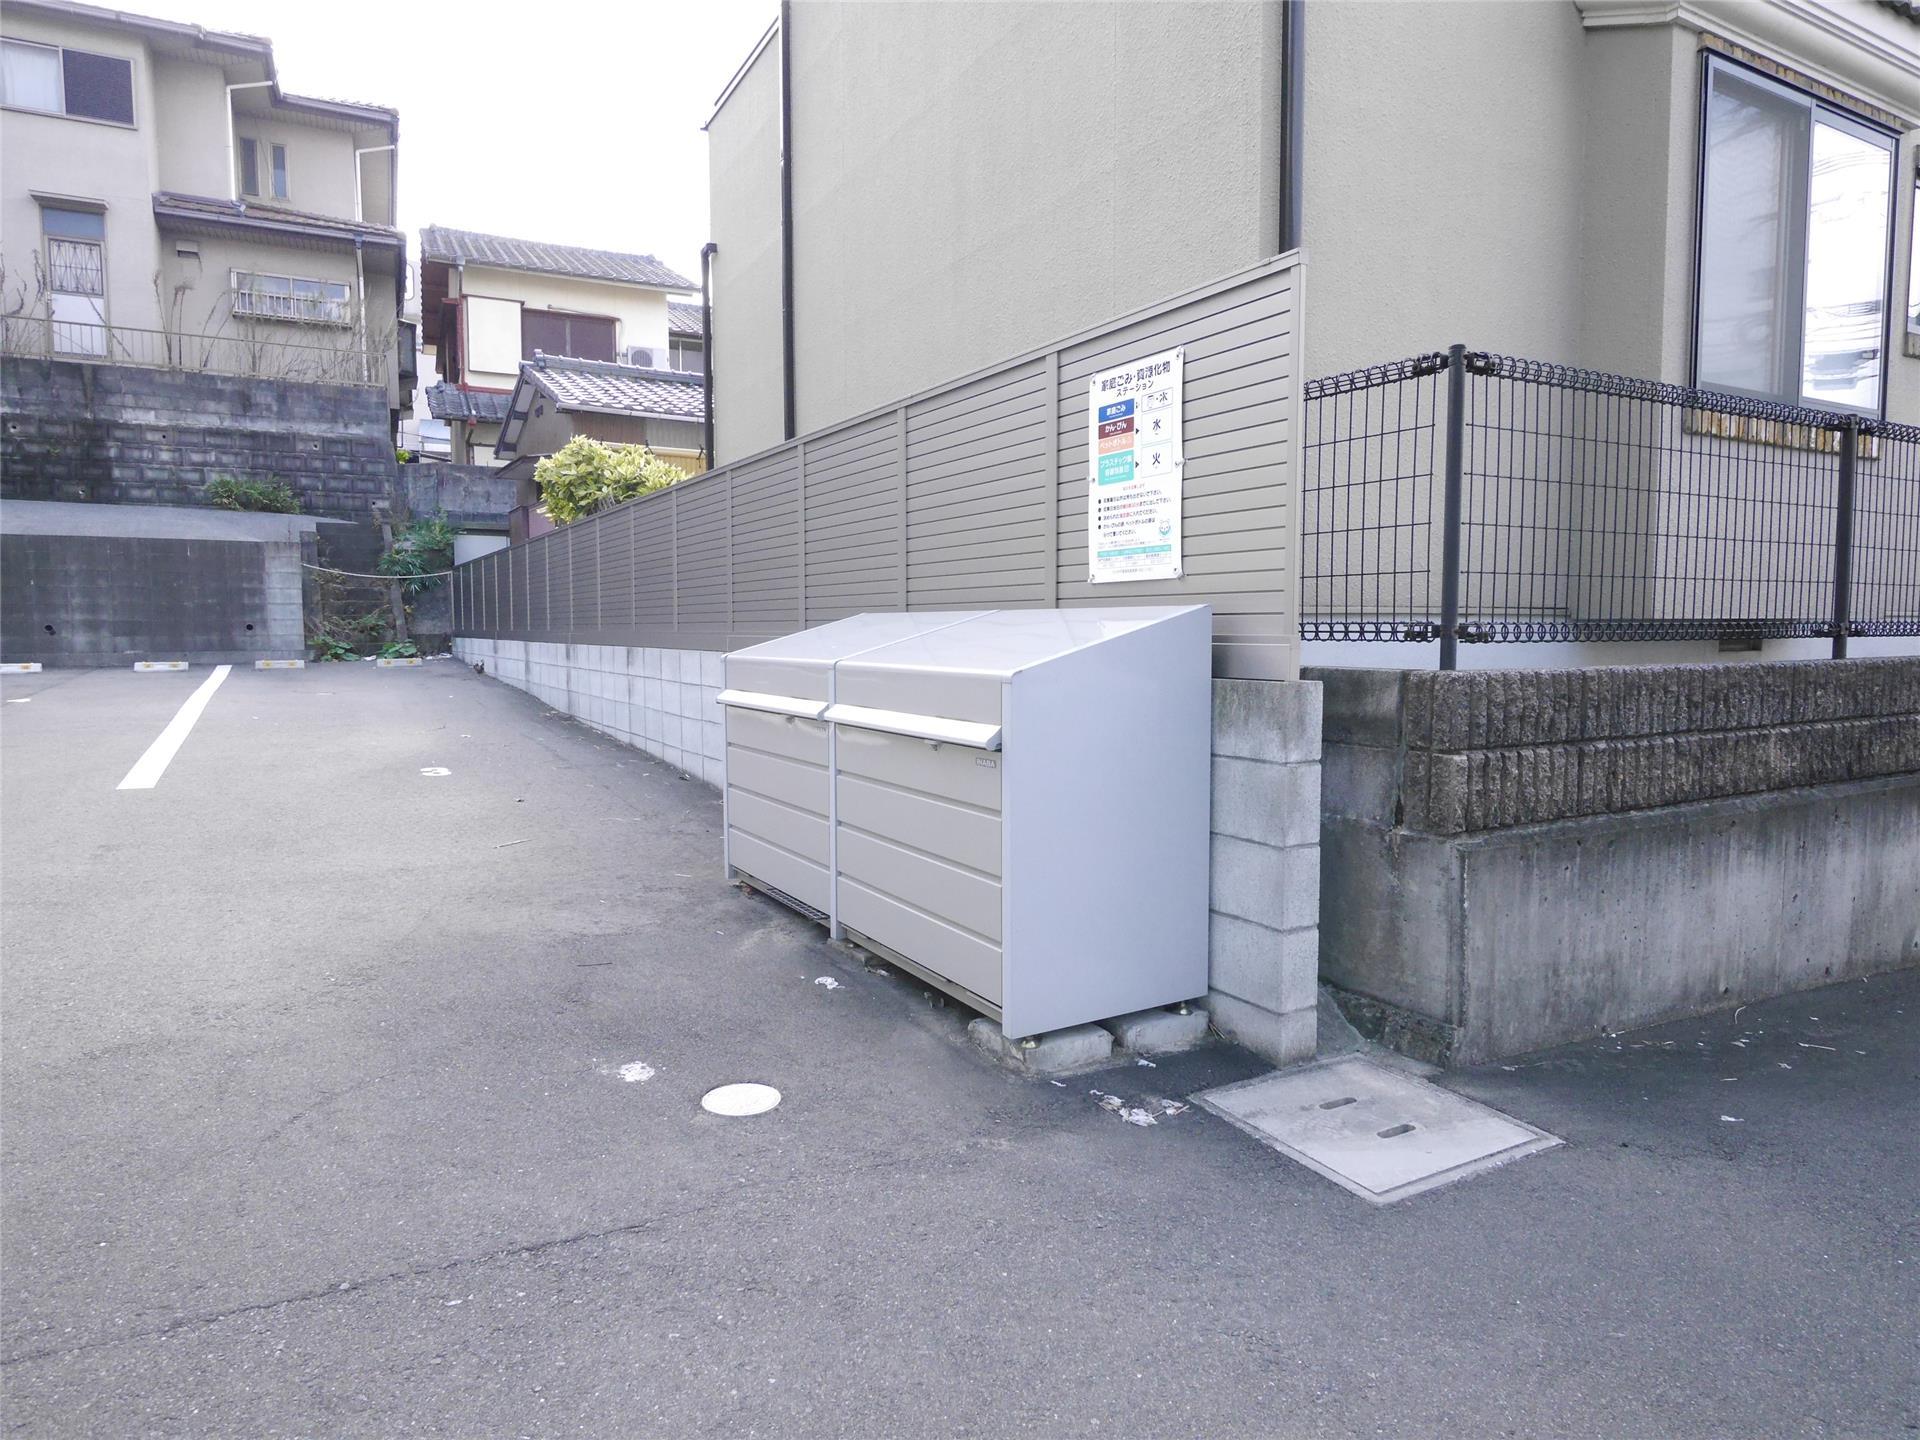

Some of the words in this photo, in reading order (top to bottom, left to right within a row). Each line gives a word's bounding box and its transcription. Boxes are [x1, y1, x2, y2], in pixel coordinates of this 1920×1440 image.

[1116, 380, 1154, 397] ステーション
[1152, 418, 1161, 431] 水
[1152, 452, 1161, 465] 火
